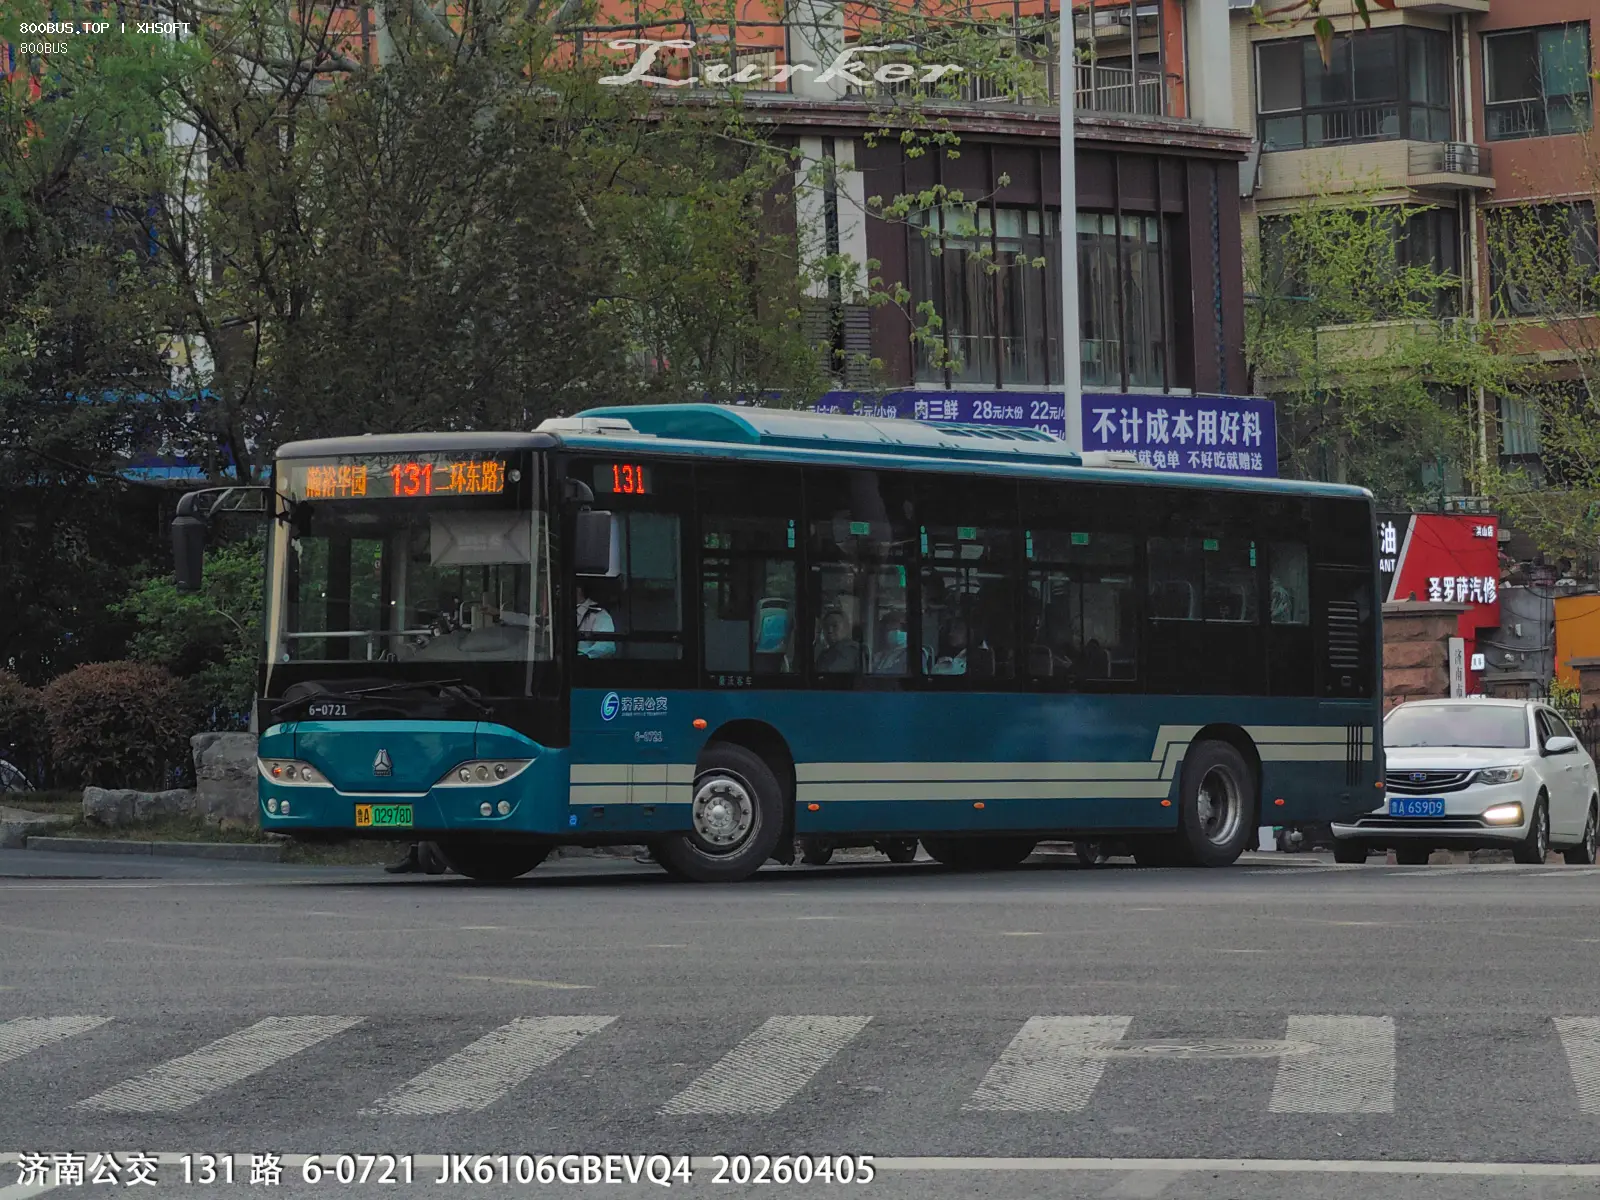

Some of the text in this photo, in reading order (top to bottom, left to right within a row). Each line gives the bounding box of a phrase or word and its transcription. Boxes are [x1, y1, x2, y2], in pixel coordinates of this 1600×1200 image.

[914, 399, 960, 420] 肉三鲜
[972, 400, 1023, 420] 28元/大份
[1092, 407, 1263, 447] 不计成本用好料
[1188, 450, 1263, 471] 不好吃就赠送
[390, 462, 433, 497] 131
[612, 464, 645, 494] 131
[1380, 520, 1397, 554] 油
[1428, 576, 1497, 604] 圣罗萨汽修
[308, 704, 347, 716] 6-0721
[621, 696, 668, 711] 济南公交
